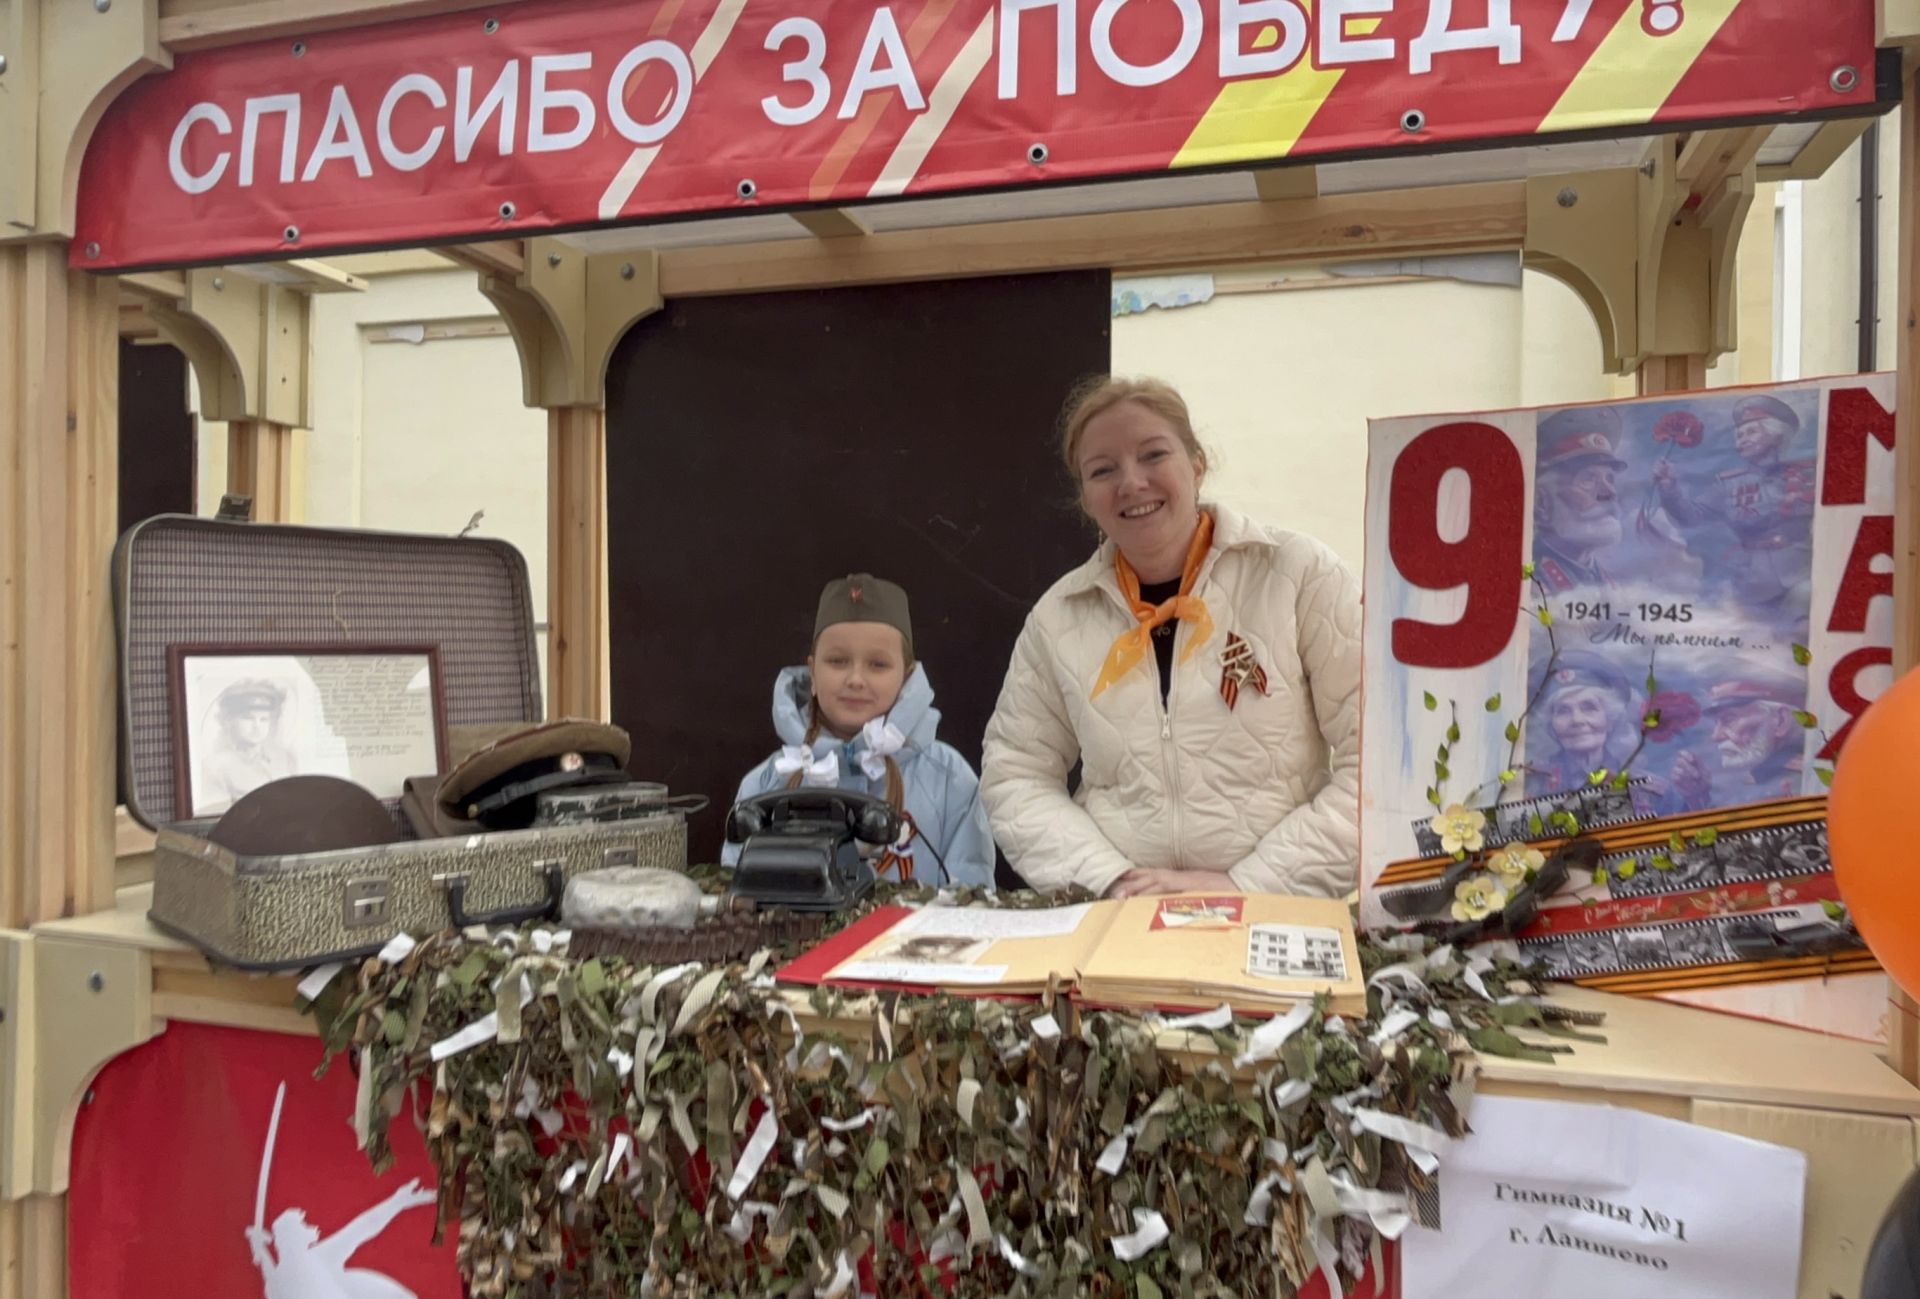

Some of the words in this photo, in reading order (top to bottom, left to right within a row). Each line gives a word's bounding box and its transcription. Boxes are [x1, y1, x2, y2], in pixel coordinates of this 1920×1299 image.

[167, 39, 693, 194] СПАСИБО
[761, 6, 927, 126] ЗА
[1388, 421, 1526, 669] 9
[1564, 601, 1612, 621] 1941
[1637, 603, 1693, 622] 1945
[1589, 622, 1648, 645] Мы
[1494, 1182, 1633, 1225] Гимназия
[1509, 1226, 1530, 1244] г.
